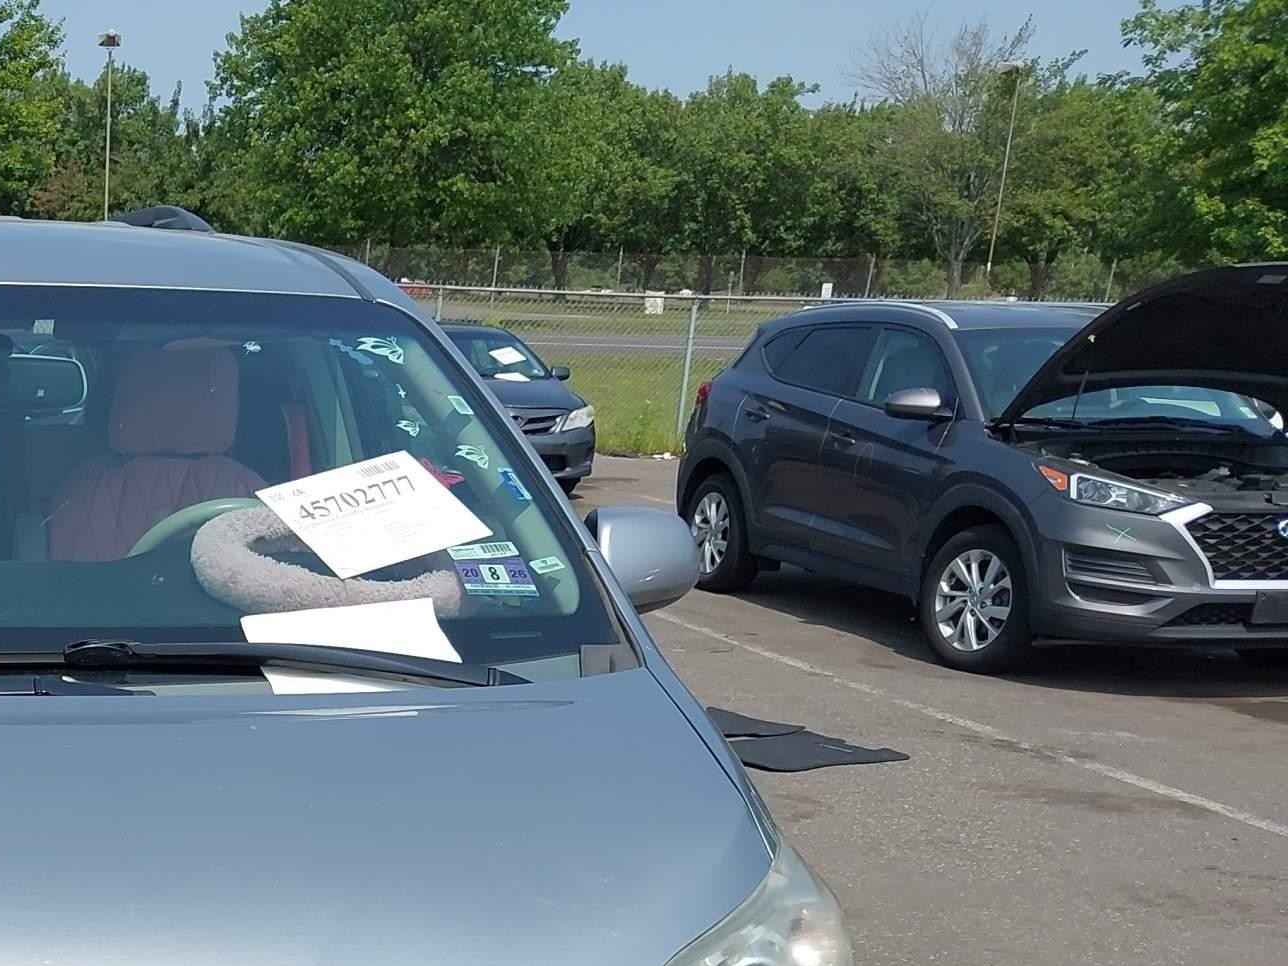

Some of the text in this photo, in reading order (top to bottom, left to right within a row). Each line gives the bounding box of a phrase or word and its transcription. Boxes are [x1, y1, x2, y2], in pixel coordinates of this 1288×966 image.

[299, 475, 416, 520] 45702777
[462, 566, 528, 581] 20 8 26
